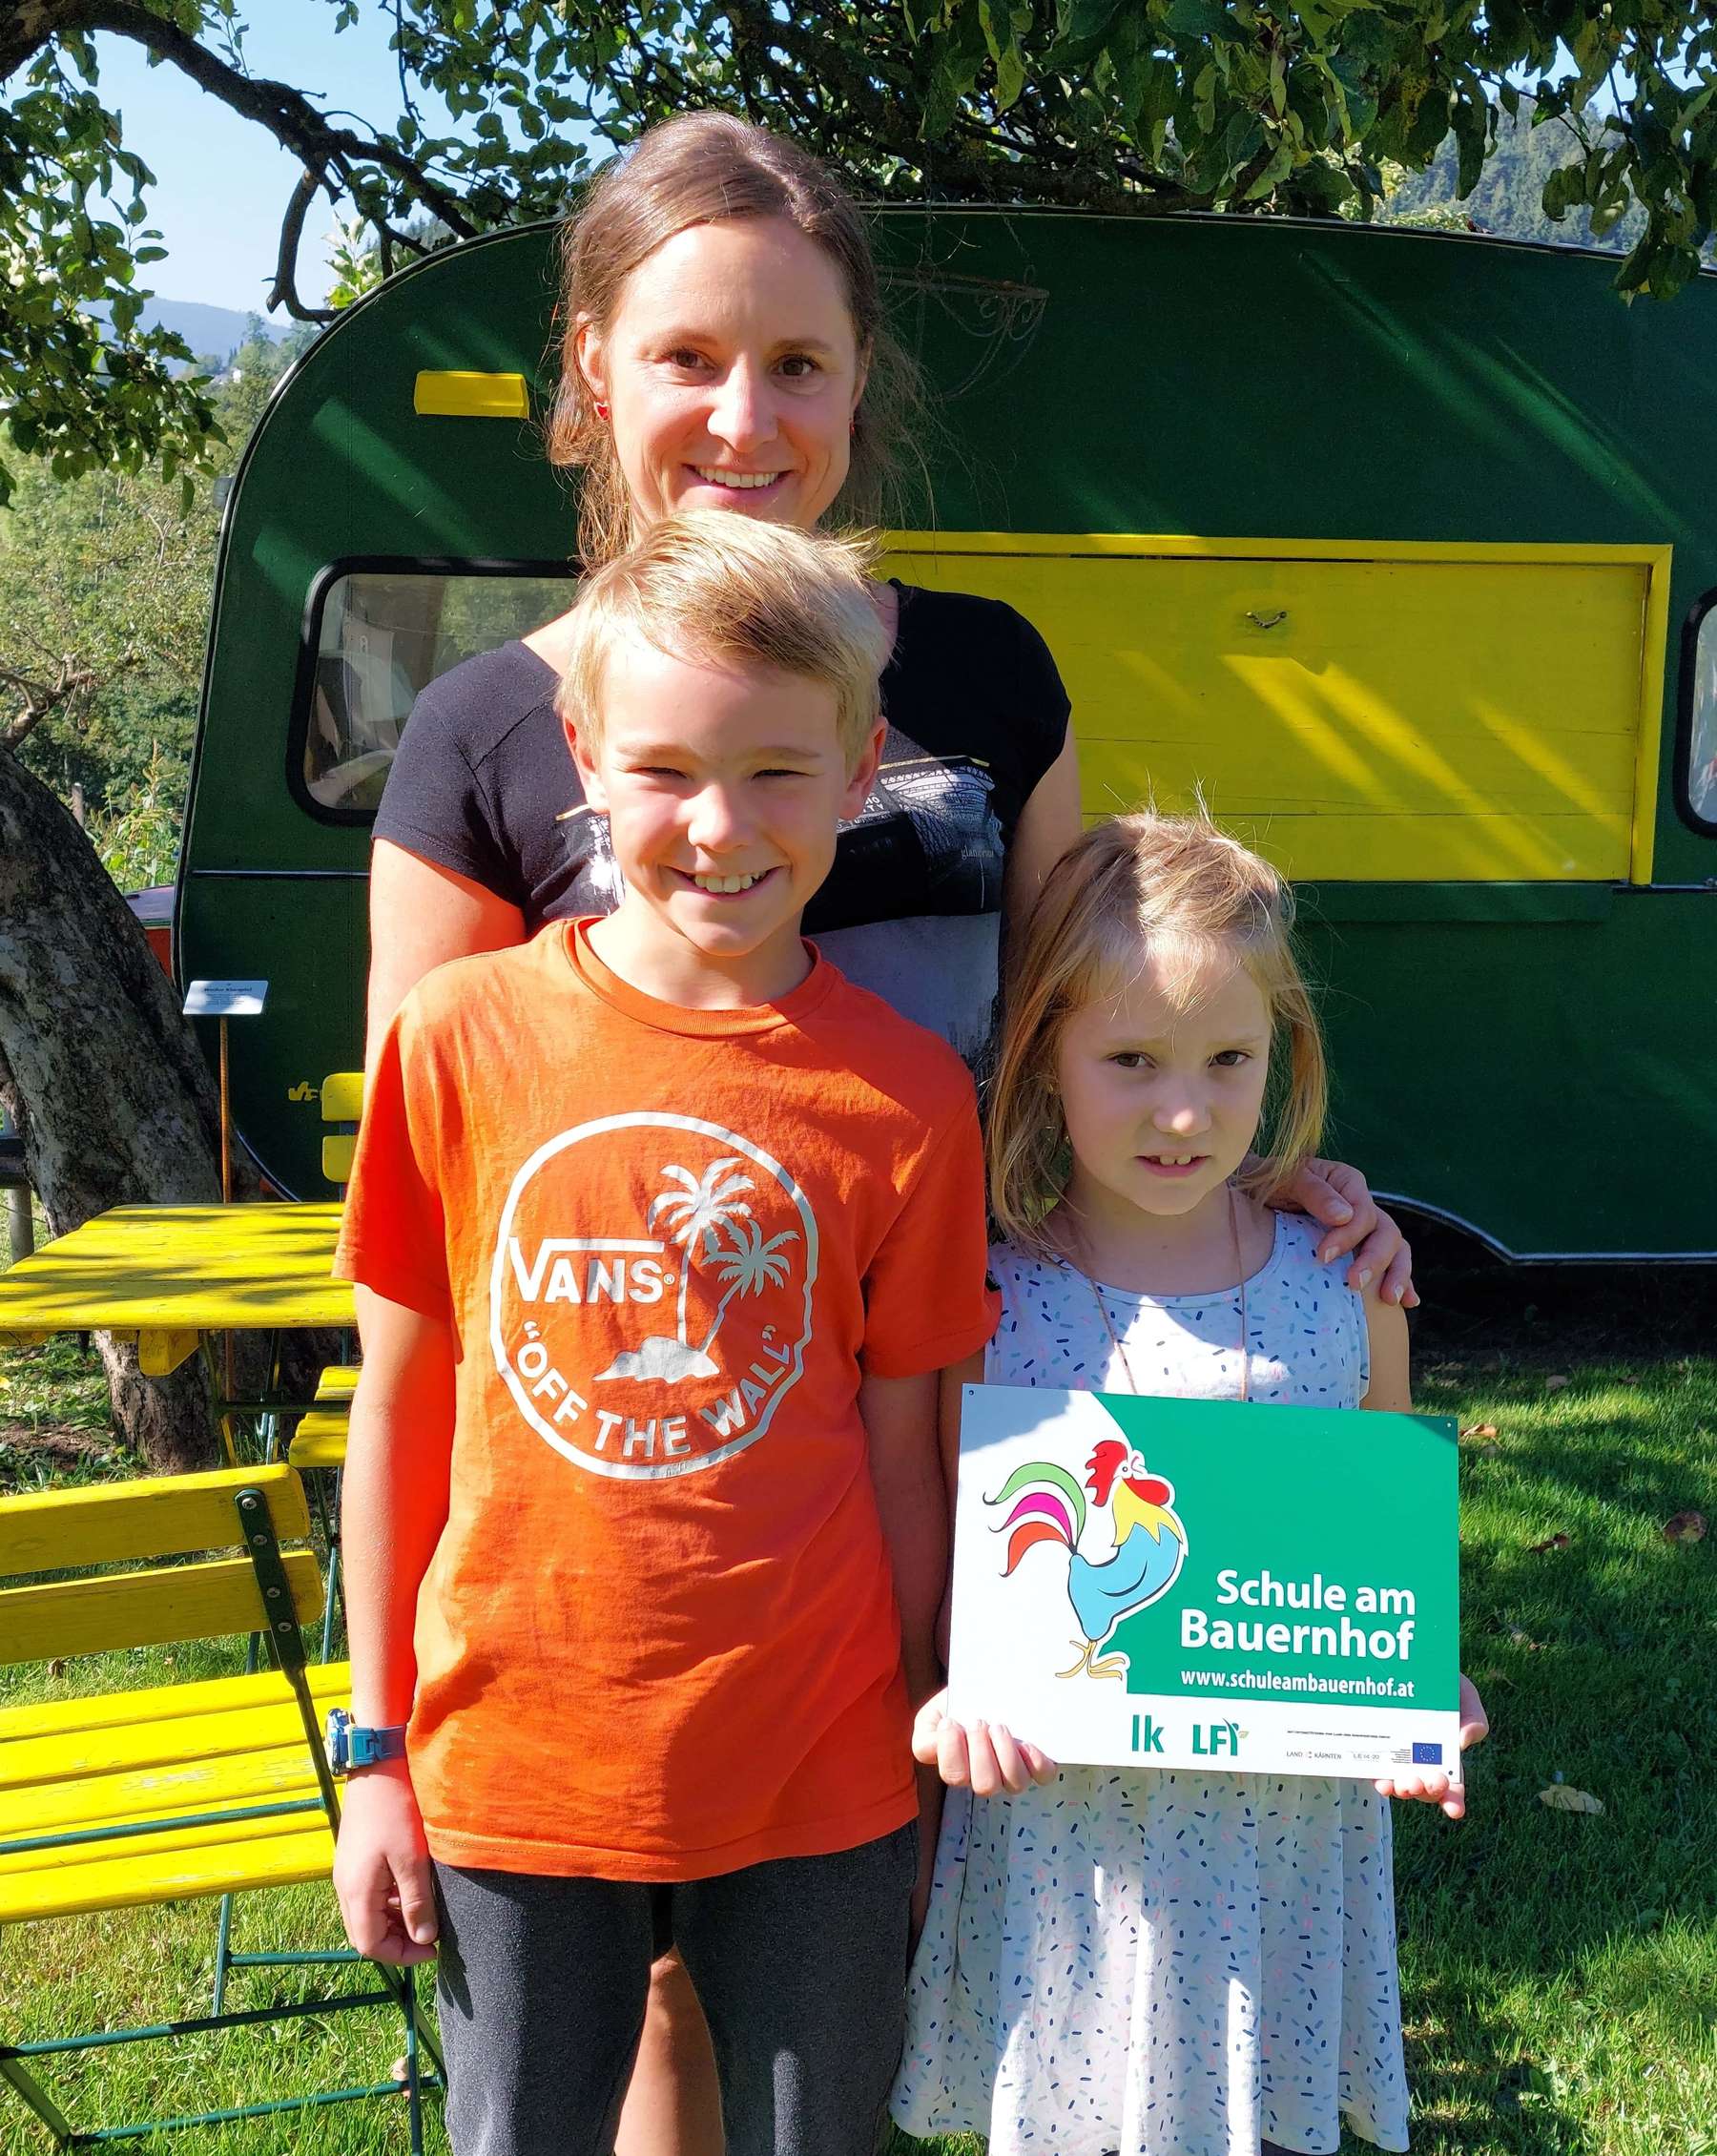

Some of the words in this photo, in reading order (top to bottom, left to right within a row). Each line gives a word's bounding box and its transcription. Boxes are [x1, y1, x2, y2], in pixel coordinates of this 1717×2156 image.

[593, 1408, 692, 1459] THE
[1215, 1569, 1347, 1611] Schule
[1355, 1586, 1416, 1615] am
[1181, 1608, 1415, 1660] Bauernhof
[1181, 1669, 1415, 1697] www.schuleambauernhof.at
